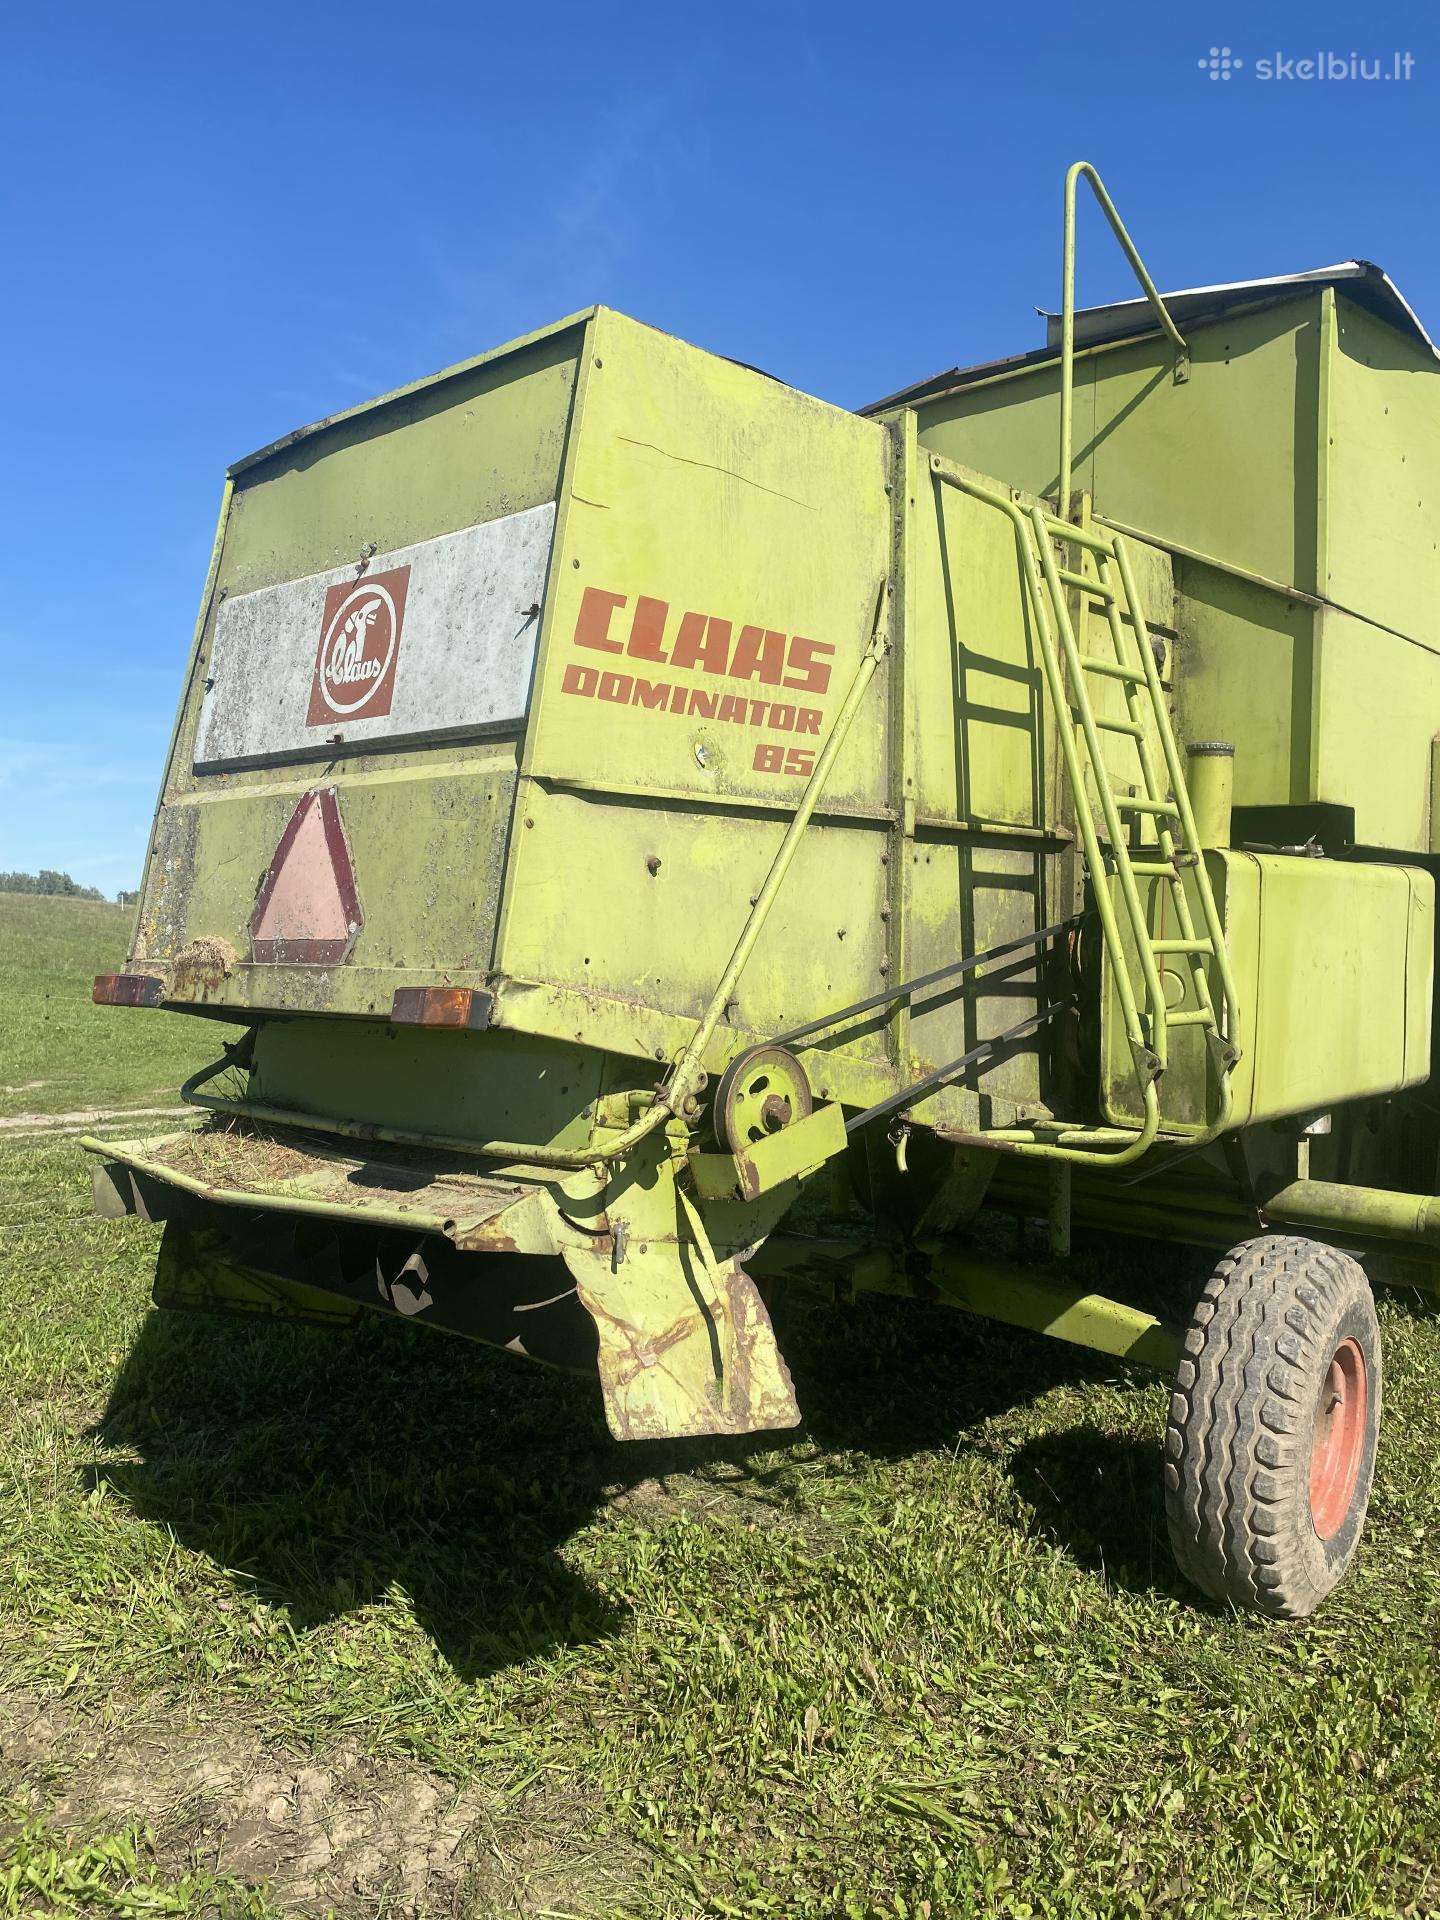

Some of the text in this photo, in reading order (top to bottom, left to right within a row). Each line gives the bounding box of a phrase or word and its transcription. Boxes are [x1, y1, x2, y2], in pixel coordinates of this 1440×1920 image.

[325, 629, 382, 686] Claas
[573, 586, 836, 695] CLAAS
[560, 663, 824, 736] DOMINATOR
[751, 743, 816, 777] 85
